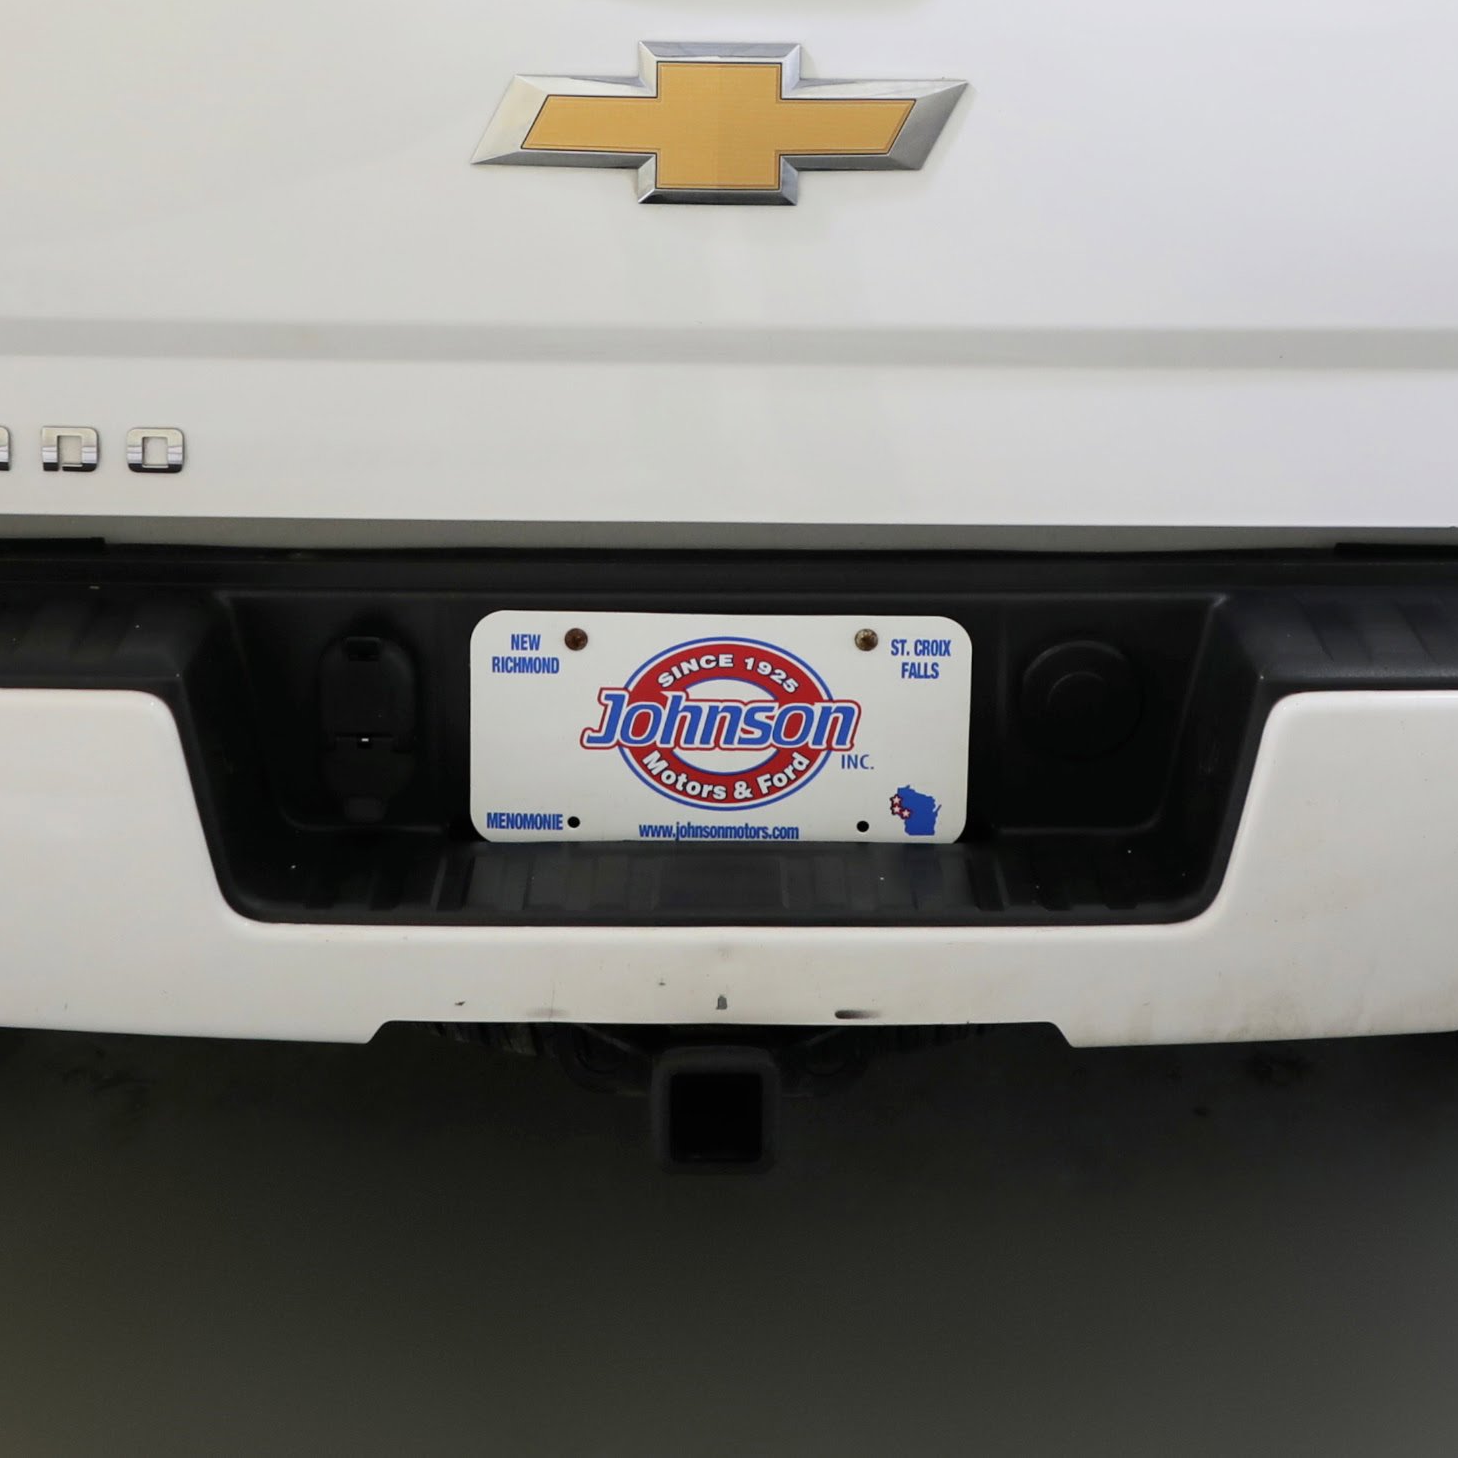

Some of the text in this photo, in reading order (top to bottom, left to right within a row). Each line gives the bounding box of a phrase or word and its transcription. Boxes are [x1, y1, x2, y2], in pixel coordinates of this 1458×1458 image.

[511, 634, 541, 651] NEW
[891, 639, 951, 657] ST. CROIX
[492, 656, 560, 674] RICHMOND
[657, 654, 800, 694] SINCE 1925
[901, 662, 939, 679] FALLS
[582, 689, 860, 749] Johnson
[841, 754, 875, 770] INC.
[642, 750, 810, 800] Motors & Ford
[487, 813, 563, 831] MENOMONIE
[639, 822, 799, 841] www.johnsonmotors.com
